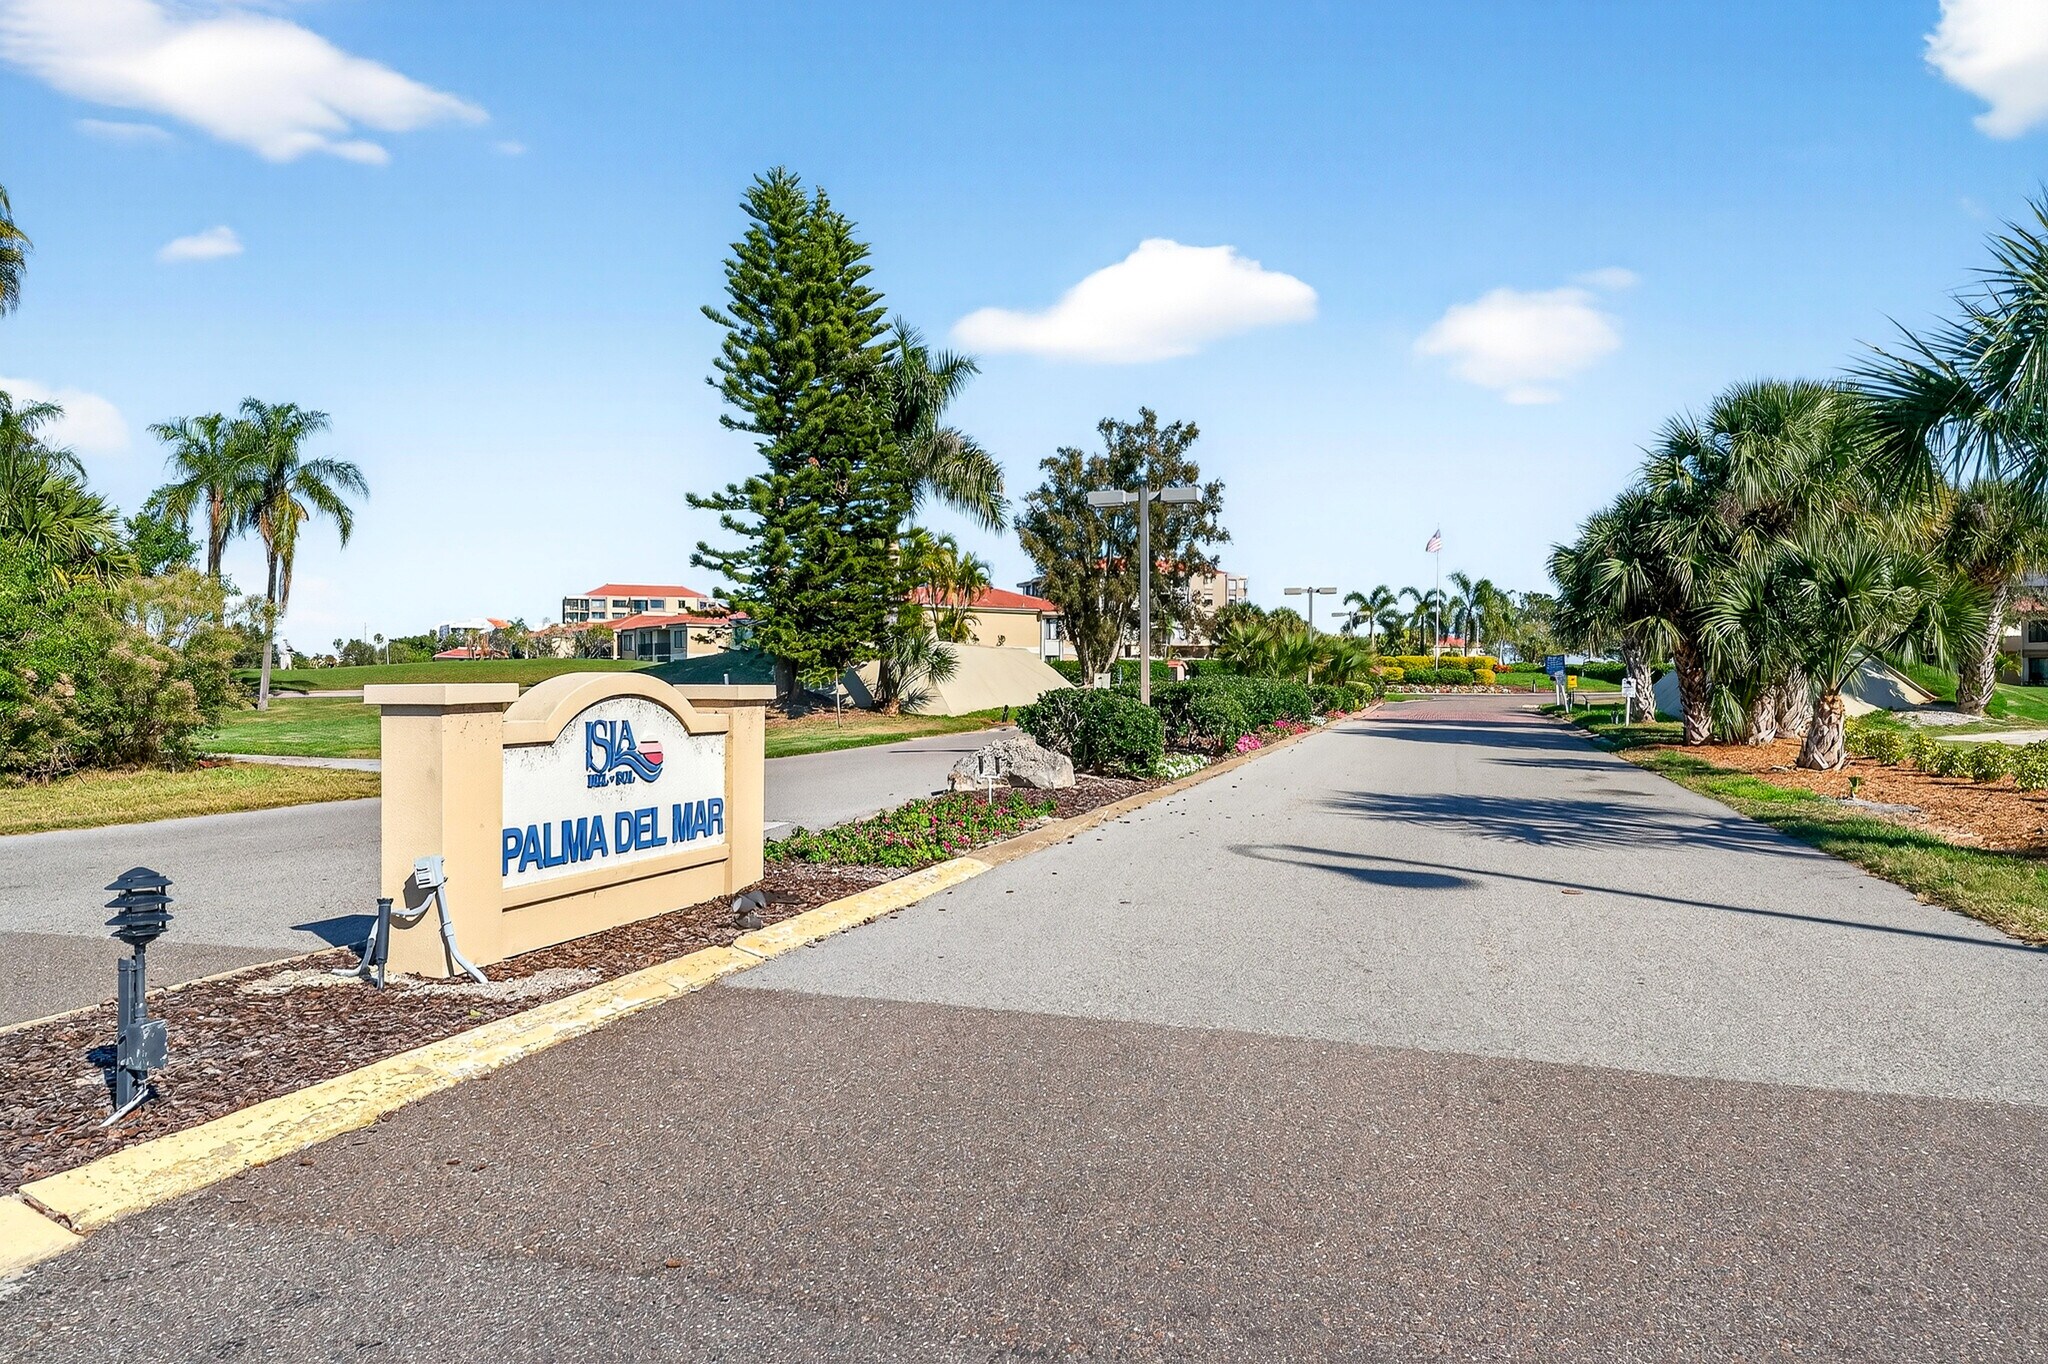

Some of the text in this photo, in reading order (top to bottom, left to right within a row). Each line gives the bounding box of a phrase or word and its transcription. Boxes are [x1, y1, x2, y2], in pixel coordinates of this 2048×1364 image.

[585, 719, 637, 773] ISLA
[502, 797, 724, 877] PALMA DEL MAR
